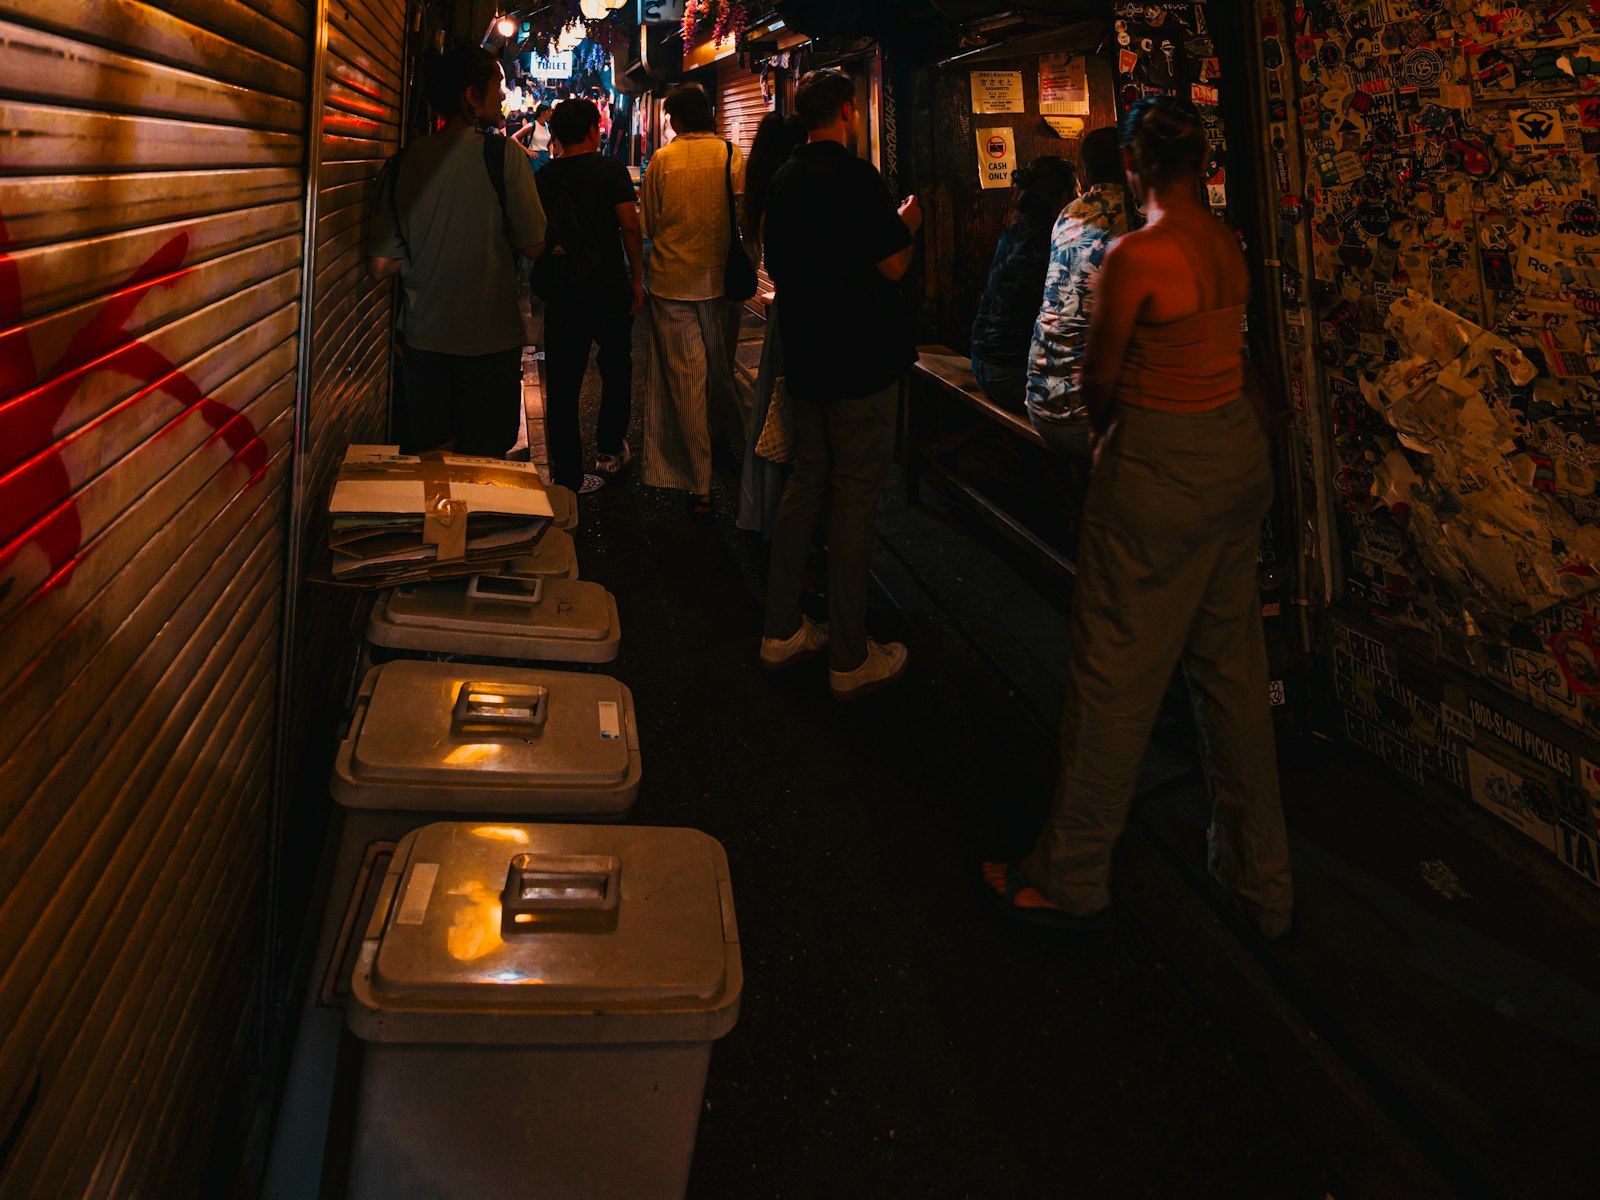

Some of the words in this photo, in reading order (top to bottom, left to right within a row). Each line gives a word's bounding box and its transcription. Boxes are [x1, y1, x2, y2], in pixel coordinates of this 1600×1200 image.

[980, 78, 1013, 87] ささもと
[988, 162, 1008, 170] CASH
[988, 171, 1008, 181] ONLY
[1527, 256, 1554, 274] Re
[1350, 632, 1386, 671] CREATE
[1469, 698, 1522, 750] 1800-SLOW
[1525, 730, 1573, 778] PICKLES
[1564, 826, 1600, 884] TA
